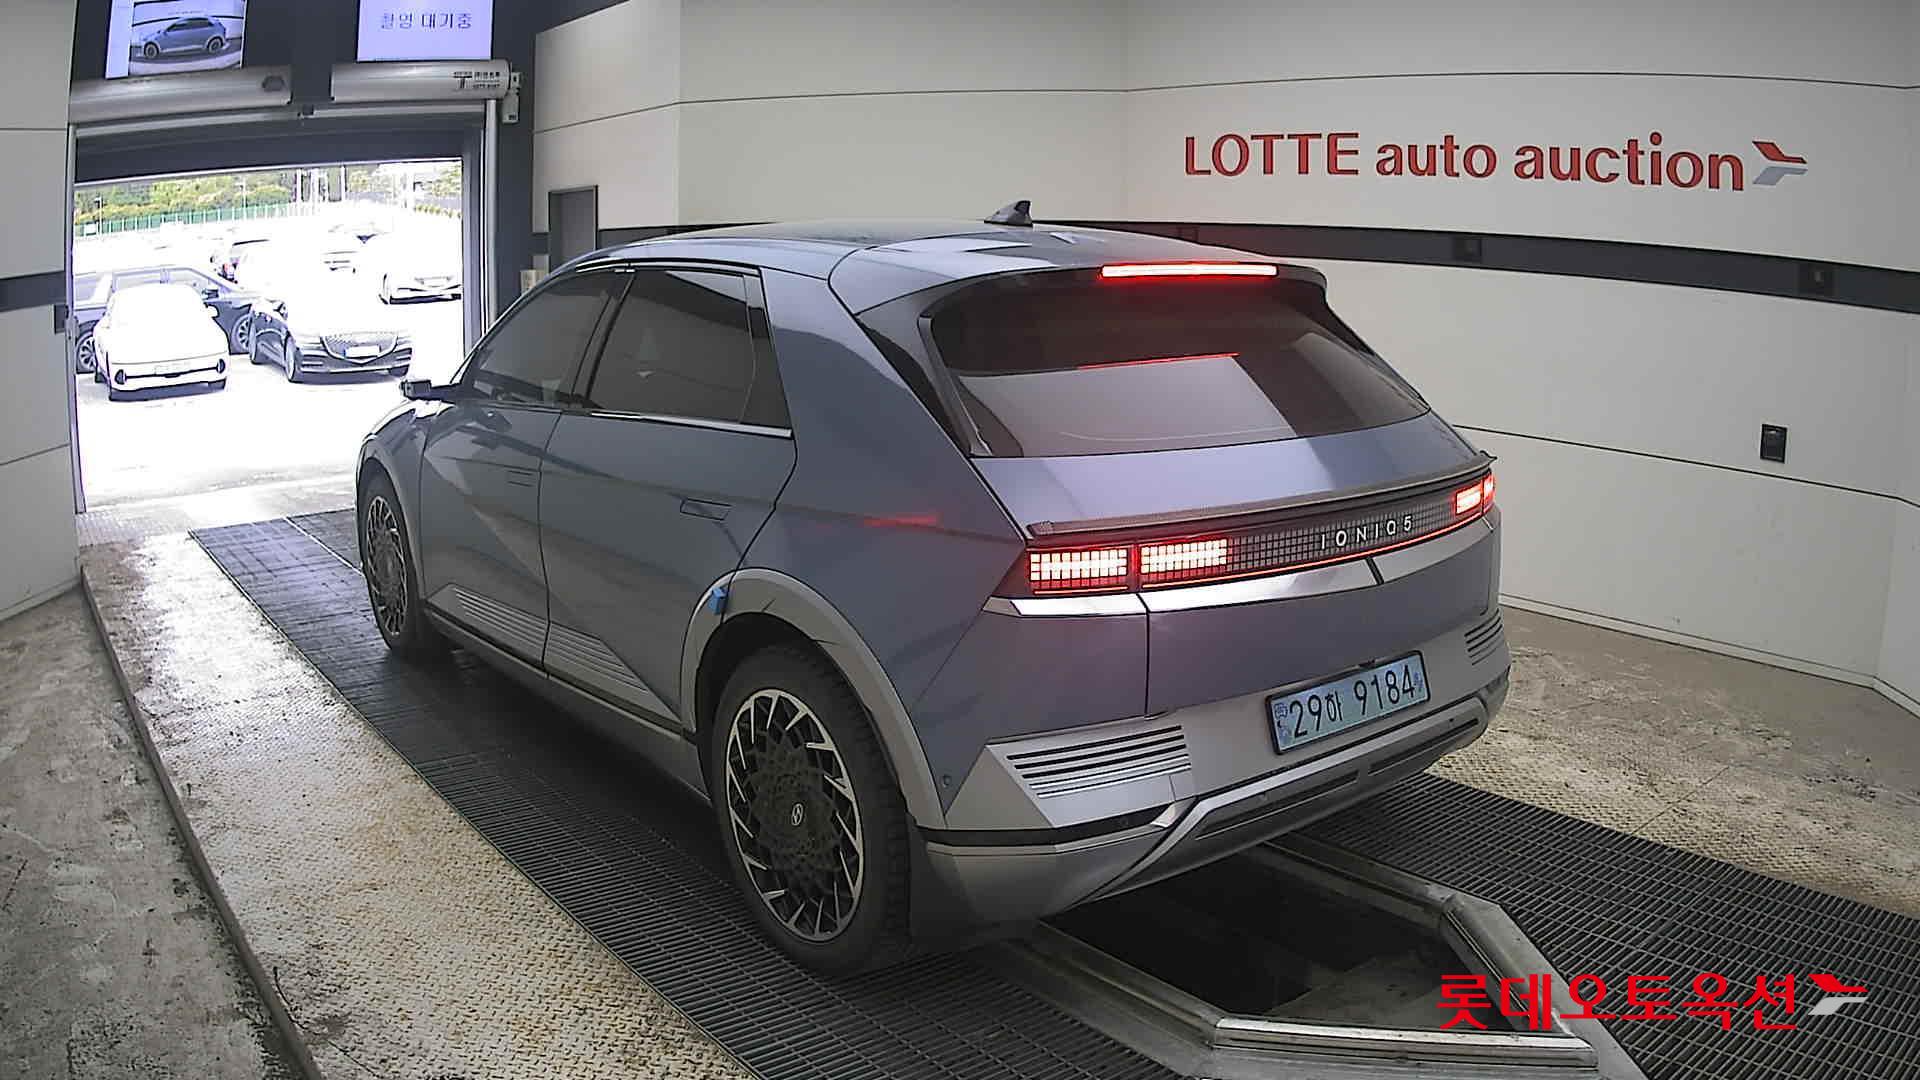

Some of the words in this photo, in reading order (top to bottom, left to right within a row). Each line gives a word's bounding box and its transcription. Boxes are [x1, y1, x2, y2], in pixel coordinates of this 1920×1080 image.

[421, 13, 472, 29] 대기중
[1185, 132, 1359, 176] LOTTE
[1376, 135, 1496, 178] auto
[1514, 132, 1744, 191] auction
[1321, 519, 1396, 550] IONIQ
[1404, 515, 1412, 532] 5
[1289, 690, 1343, 738] 29하
[1353, 664, 1415, 715] 9184
